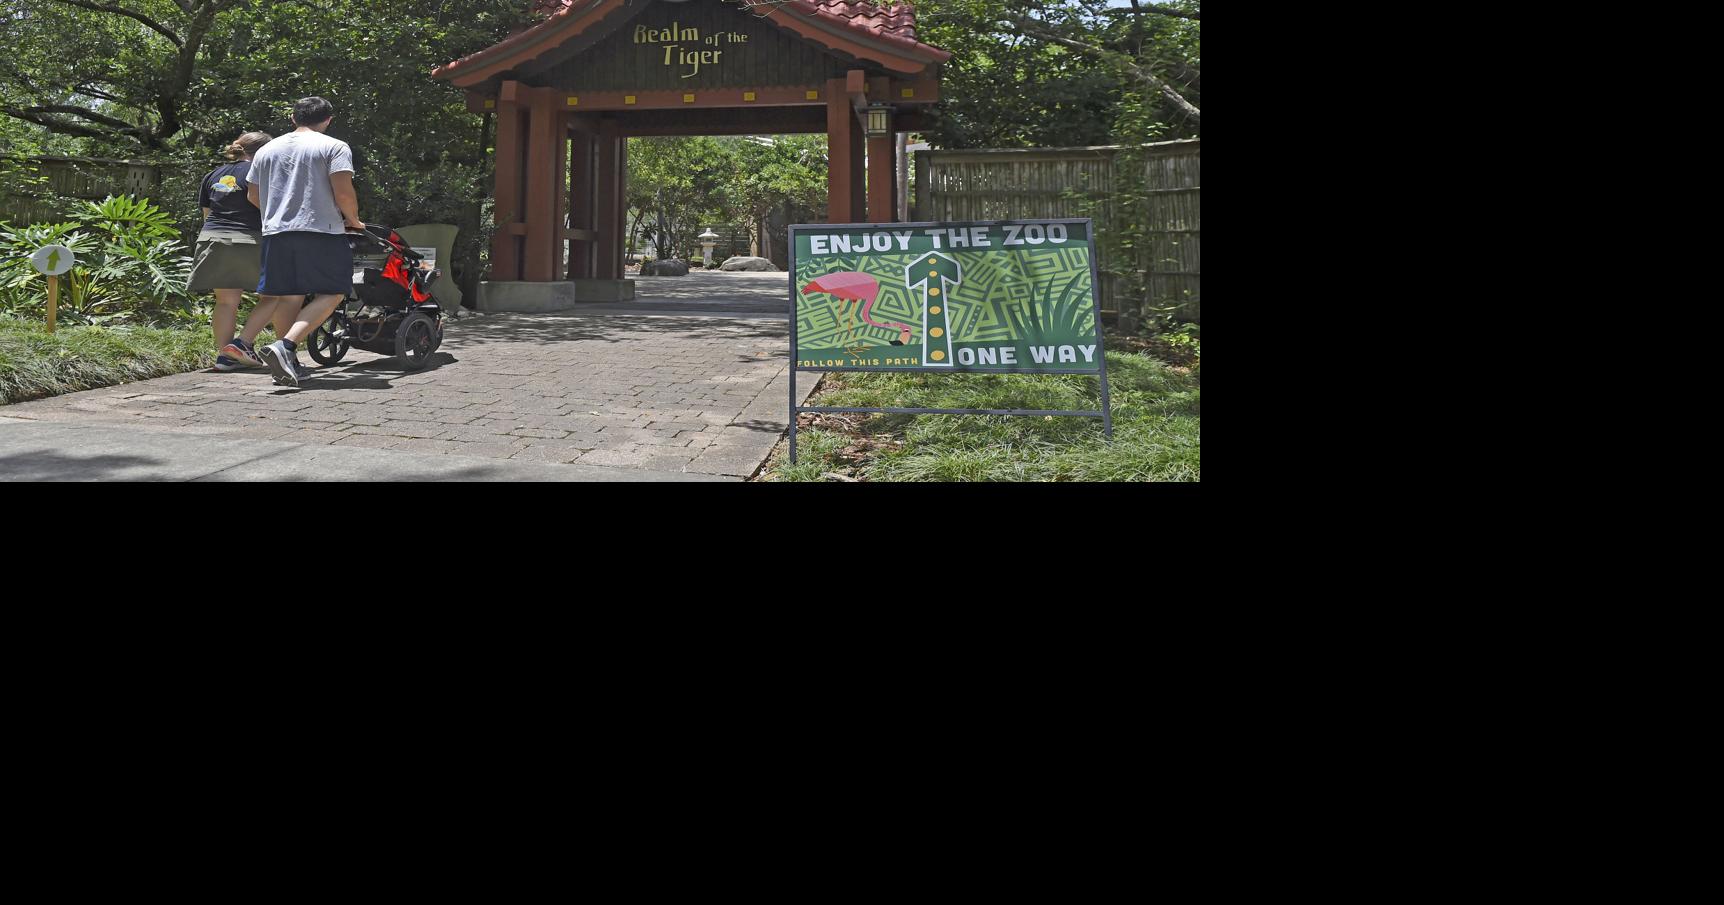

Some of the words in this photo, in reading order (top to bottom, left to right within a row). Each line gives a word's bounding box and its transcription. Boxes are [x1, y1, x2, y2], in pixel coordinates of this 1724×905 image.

[633, 21, 699, 43] Realm
[705, 31, 725, 46] of
[727, 31, 748, 43] the
[663, 44, 722, 78] Tiger
[810, 230, 913, 255] ENJOY
[925, 226, 992, 249] THE
[1003, 223, 1068, 246] ZOO
[797, 359, 844, 367] FOLLOW
[851, 358, 880, 366] THIS
[886, 357, 919, 365] PATH
[957, 346, 1018, 366] ONE
[1029, 344, 1097, 364] WAY
